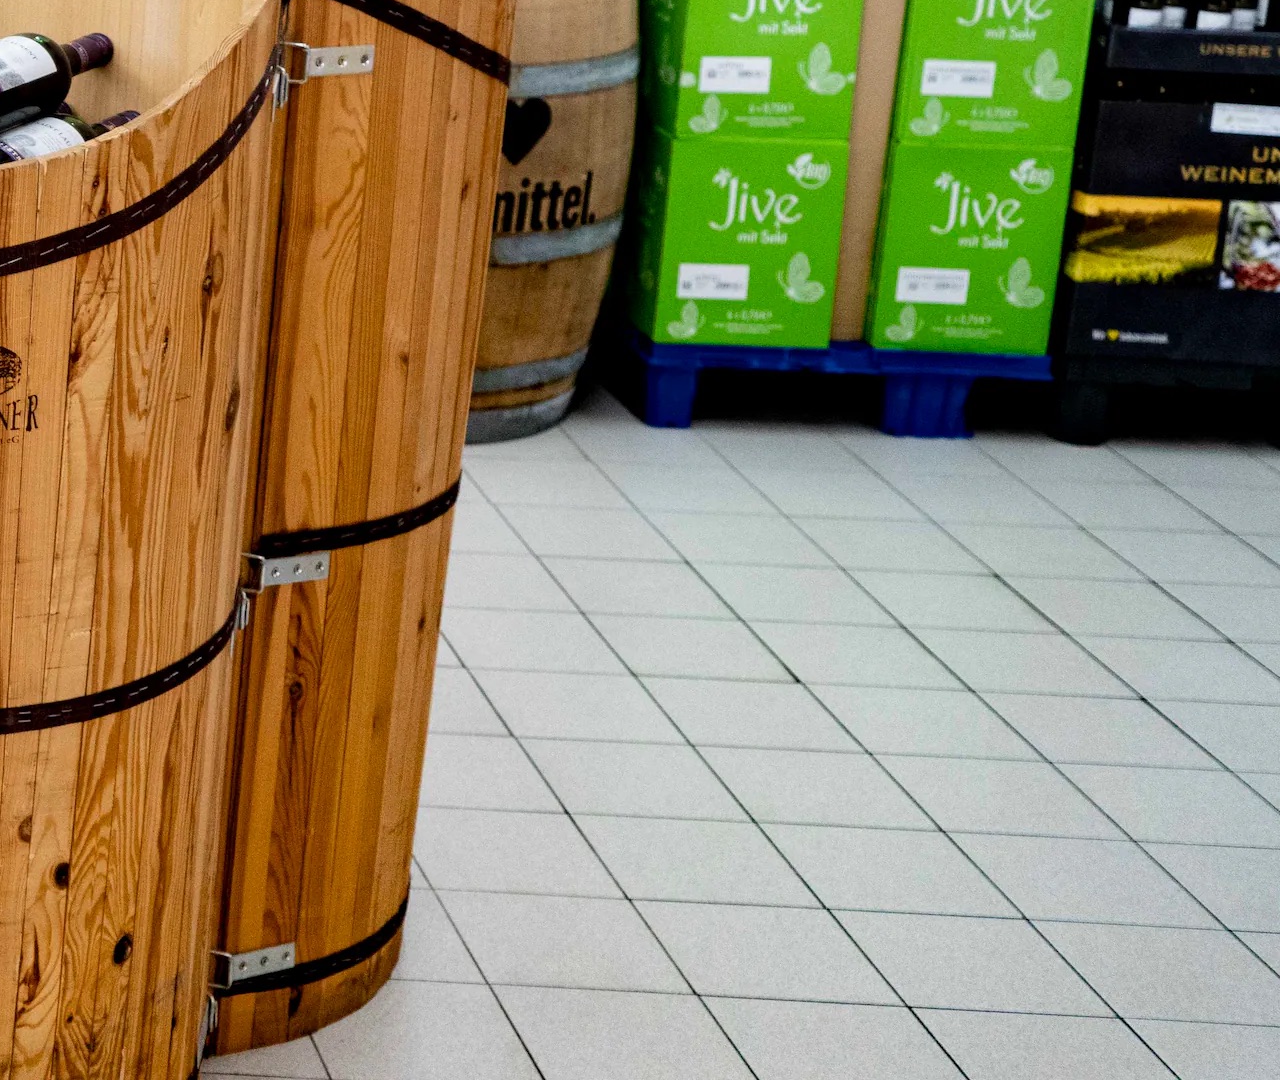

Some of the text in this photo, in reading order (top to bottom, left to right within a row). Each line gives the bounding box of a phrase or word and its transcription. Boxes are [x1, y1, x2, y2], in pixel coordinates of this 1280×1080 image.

[1199, 42, 1273, 59] UNSERE
[709, 176, 803, 232] Jive
[930, 180, 1025, 236] Jive
